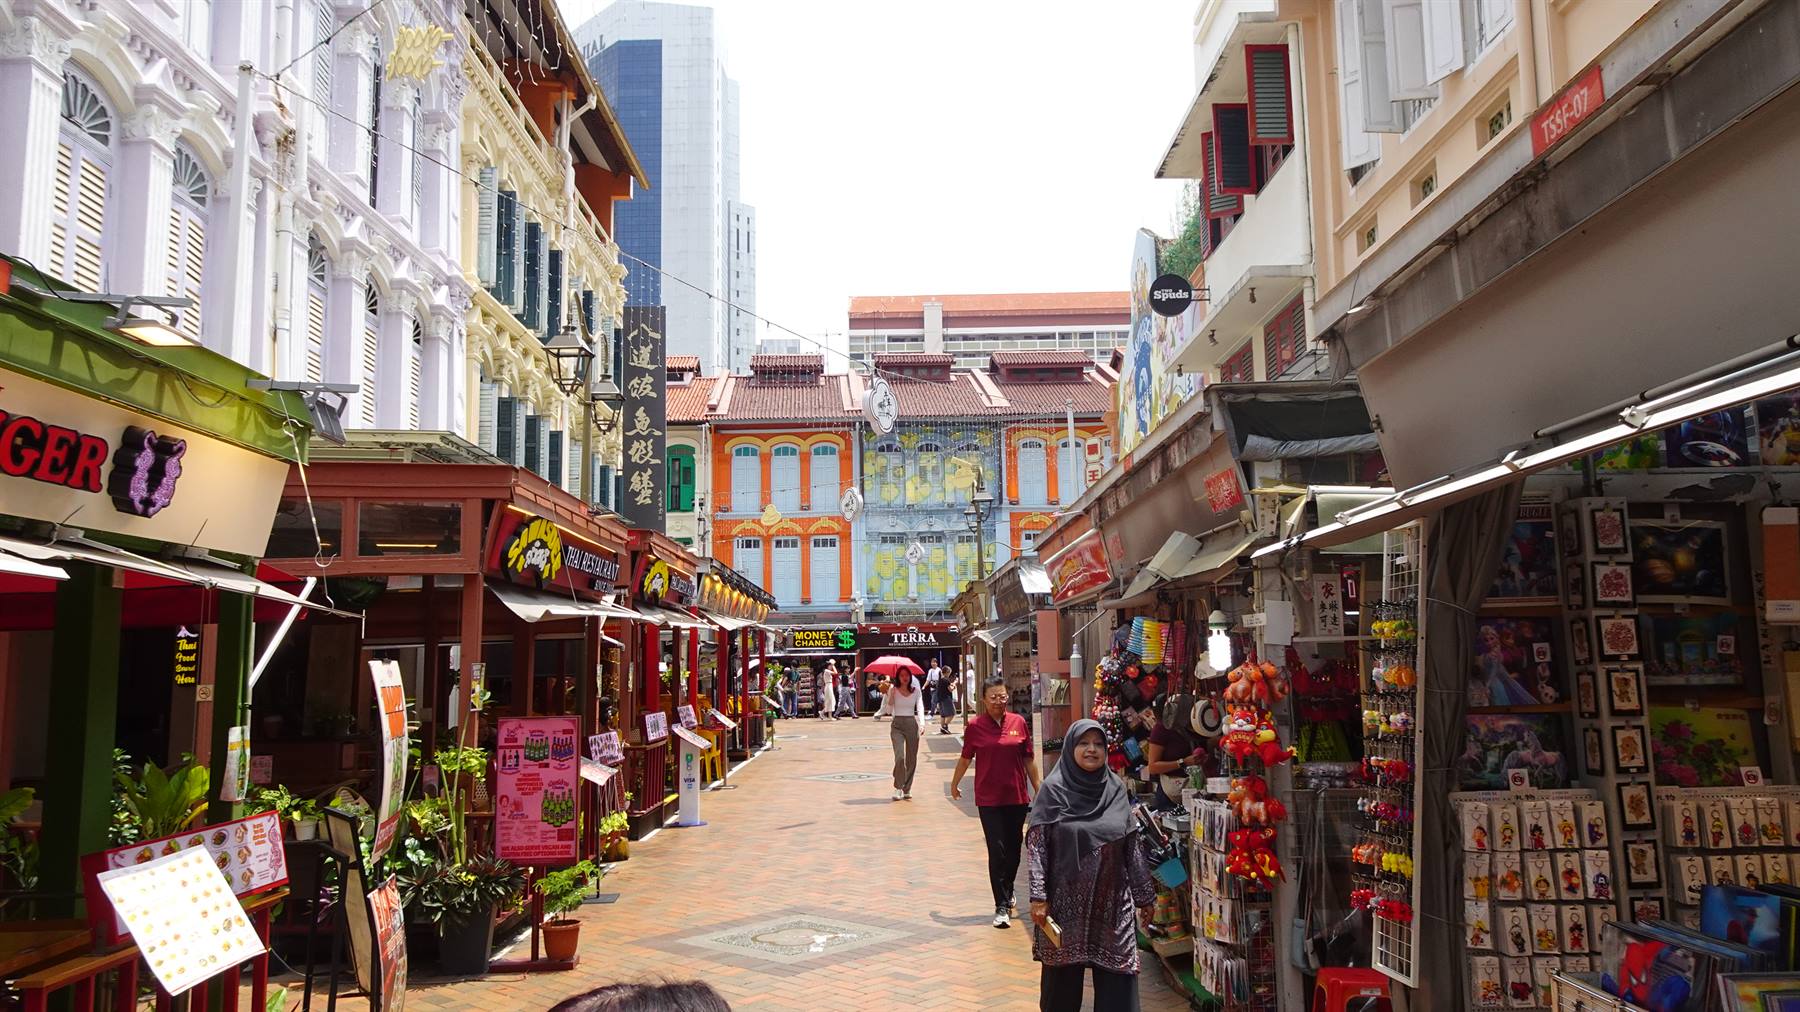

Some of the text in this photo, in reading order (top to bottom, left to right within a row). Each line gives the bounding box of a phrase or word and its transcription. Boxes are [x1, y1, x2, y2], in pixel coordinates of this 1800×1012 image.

[1541, 87, 1589, 143] TSSF-07
[1153, 289, 1189, 302] Spuds
[567, 546, 583, 569] THAI
[581, 552, 620, 581] RESTAURANT
[795, 631, 834, 640] MONEY
[891, 633, 936, 643] TERRA
[176, 639, 197, 651] Thai
[175, 652, 196, 663] Food
[175, 674, 195, 685] Here
